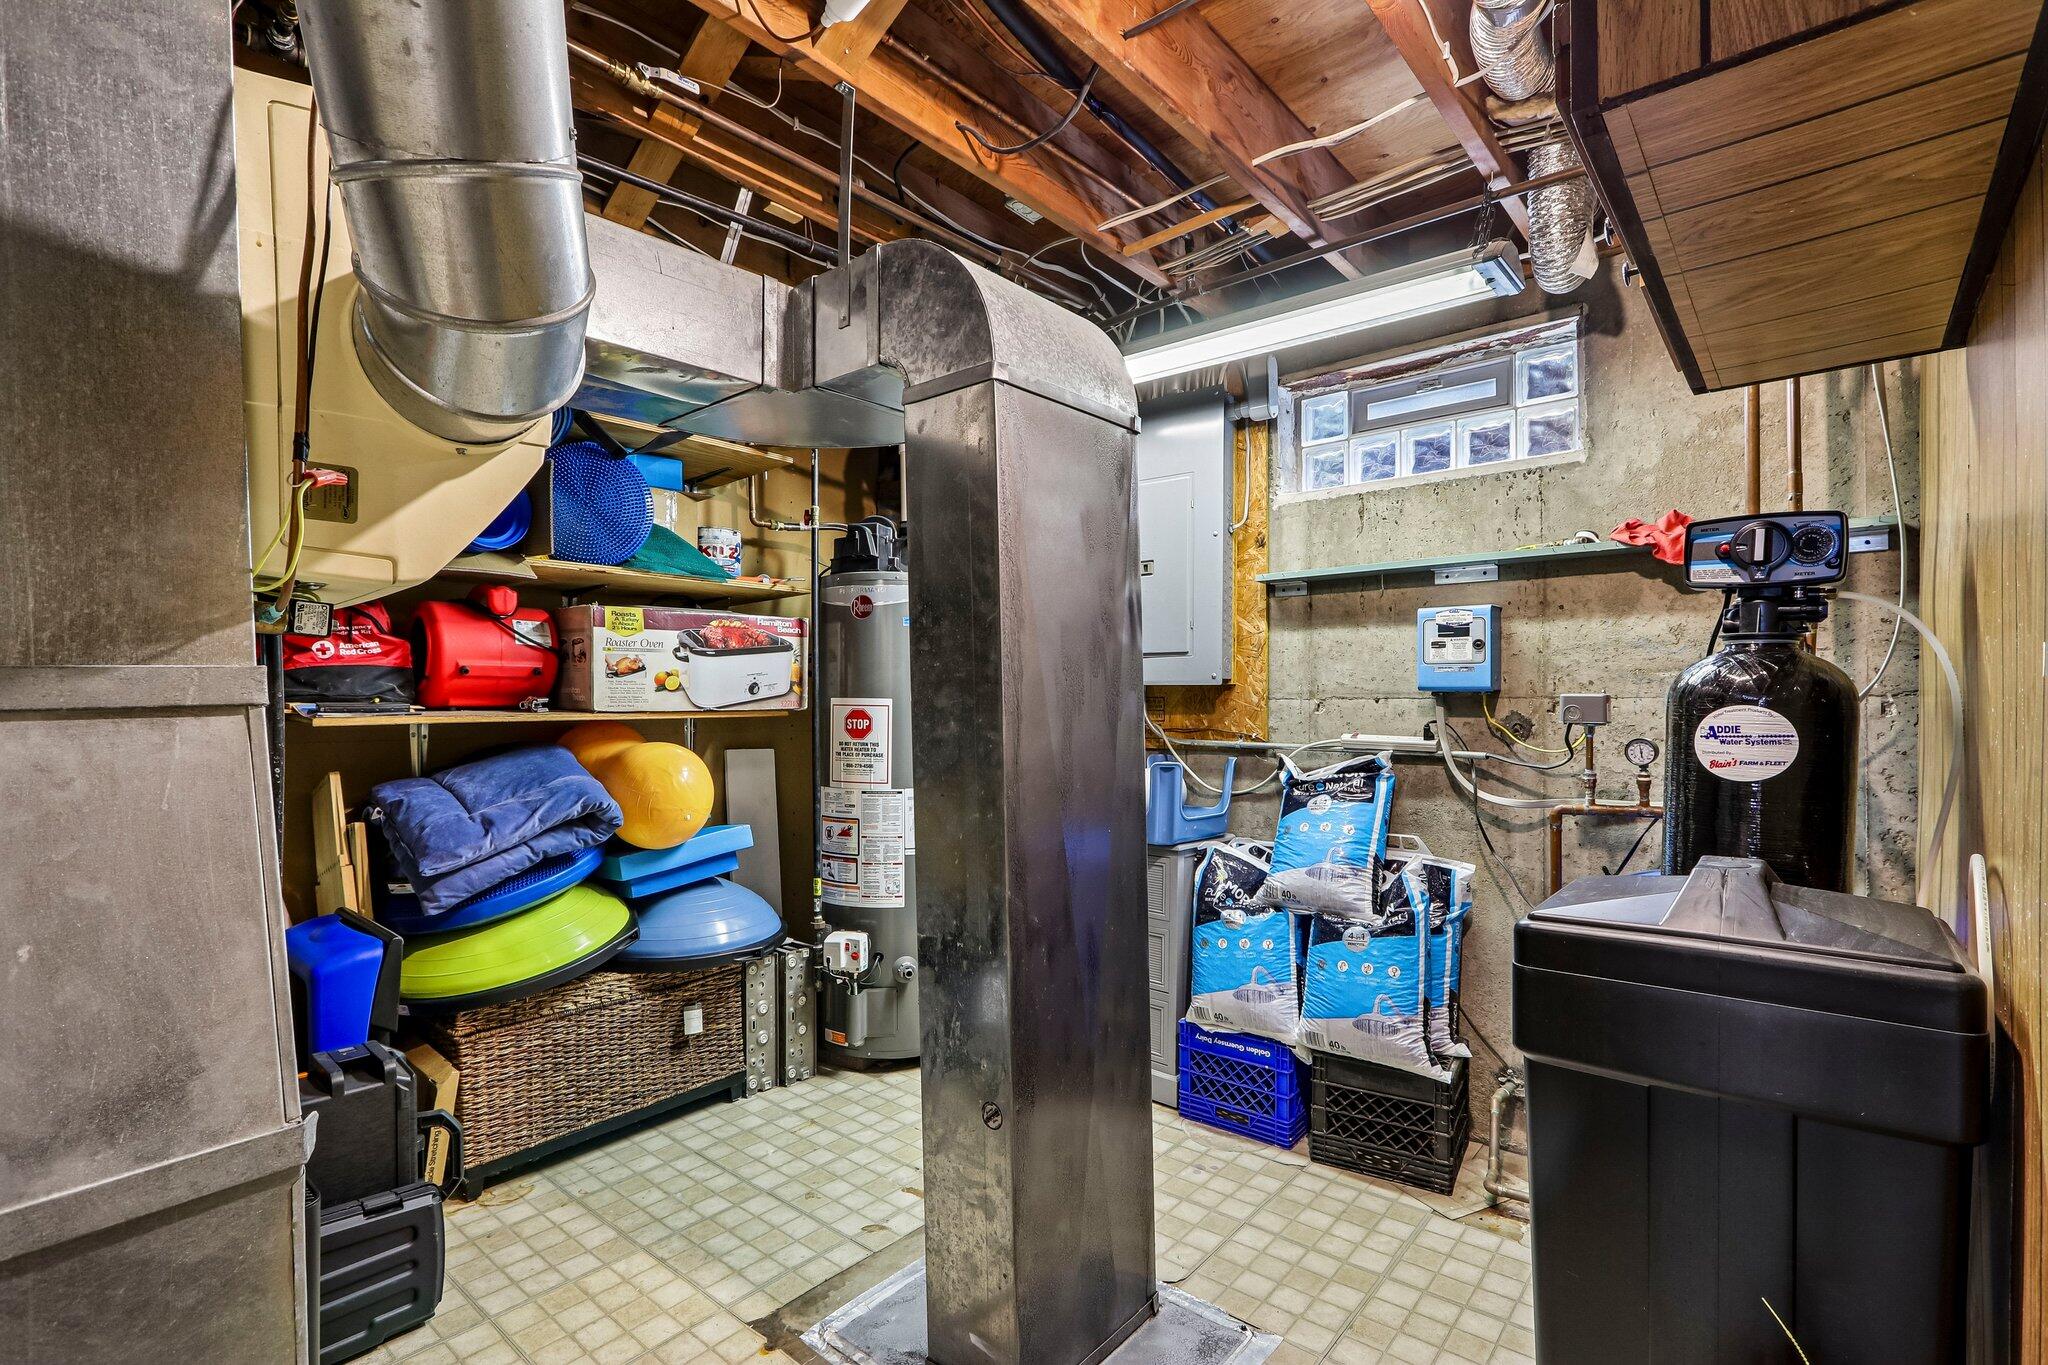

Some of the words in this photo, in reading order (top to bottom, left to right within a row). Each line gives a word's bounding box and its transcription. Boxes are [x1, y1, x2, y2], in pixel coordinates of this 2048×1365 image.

[853, 596, 873, 615] Rheem
[611, 610, 637, 618] Roasts
[757, 617, 793, 628] Hamilton
[777, 626, 802, 634] Beach
[339, 641, 380, 649] American
[605, 637, 638, 648] Roaster
[640, 638, 664, 648] Oven
[339, 648, 356, 656] Red
[357, 647, 382, 655] Cross
[1747, 707, 1768, 715] Products
[846, 718, 870, 730] STOP
[1705, 725, 1742, 740] ADDIE
[1744, 739, 1782, 747] Systems
[1709, 757, 1738, 769] Blain's
[1281, 890, 1291, 900] 40
[1213, 1012, 1223, 1021] 40
[1195, 1032, 1213, 1044] Dairy
[1213, 1037, 1245, 1052] Guernsey
[1328, 1041, 1339, 1050] 40
[1246, 1046, 1271, 1058] Golden
[428, 1130, 441, 1167] Stretching
